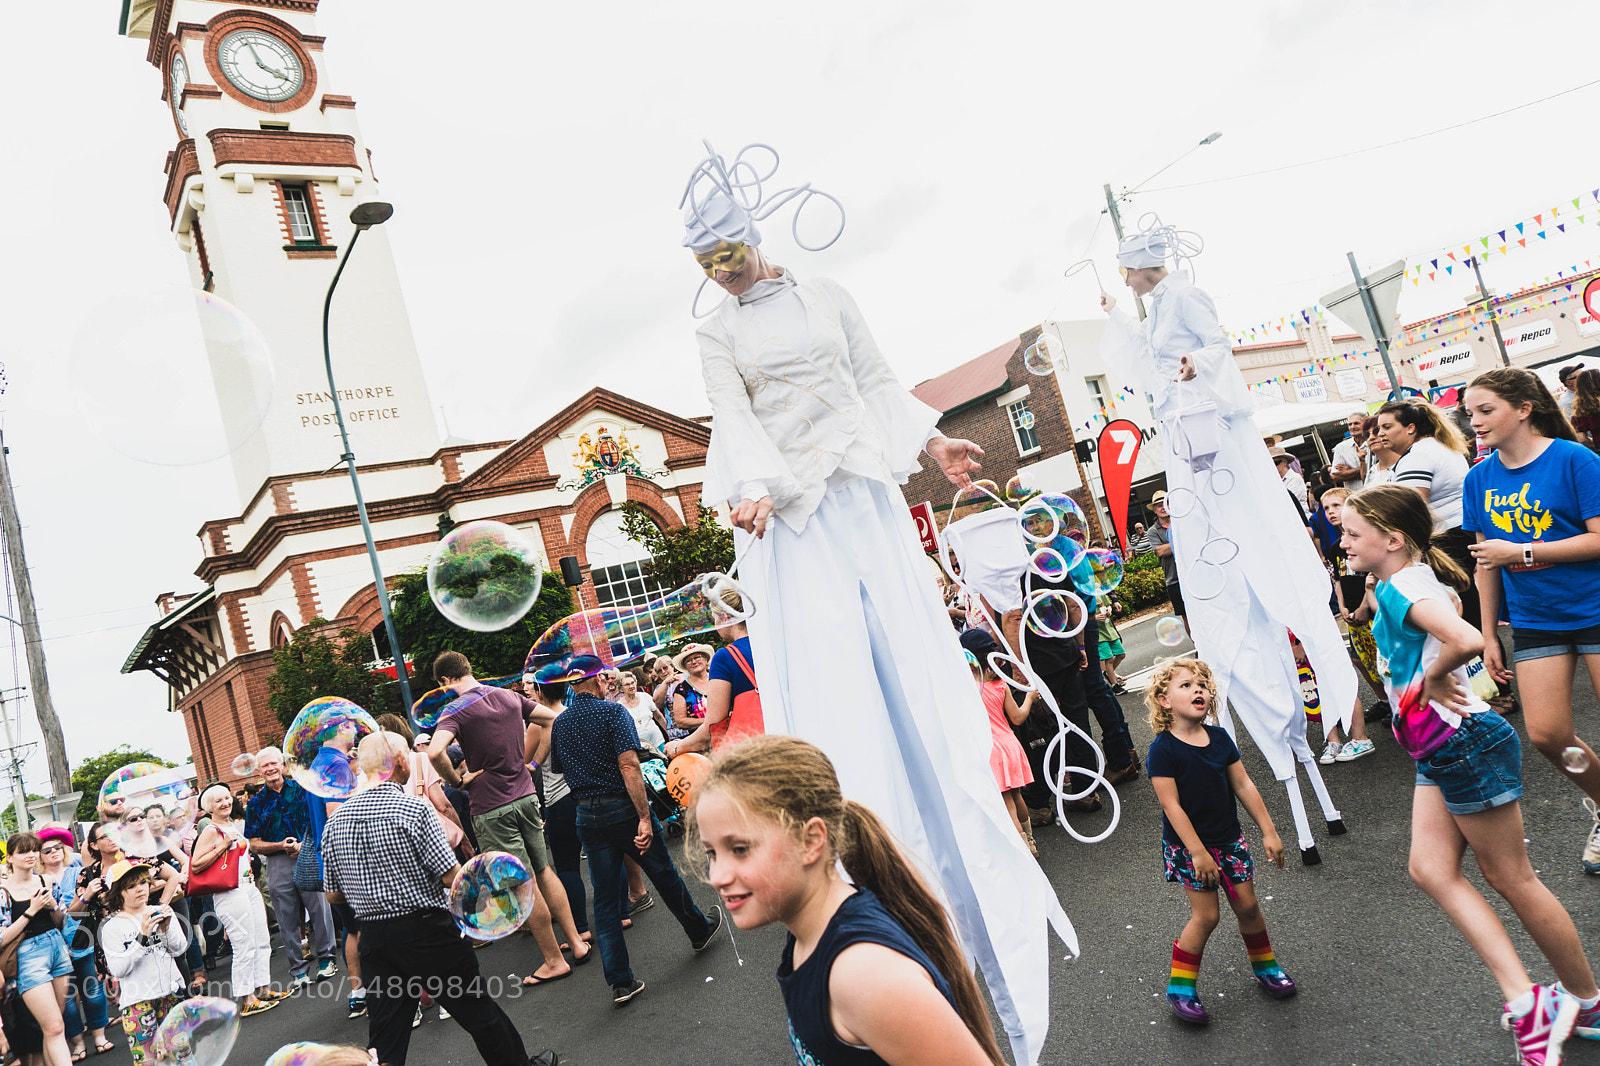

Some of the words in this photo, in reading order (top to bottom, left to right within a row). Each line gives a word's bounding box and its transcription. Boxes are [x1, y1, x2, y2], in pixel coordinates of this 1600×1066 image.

[1520, 326, 1551, 342] Repco
[1439, 350, 1470, 366] Repco
[296, 386, 394, 405] STANTHORPE
[301, 413, 338, 428] POST
[349, 407, 400, 422] OFFICE
[1484, 483, 1532, 513] Fuel
[1503, 507, 1542, 539] Fly
